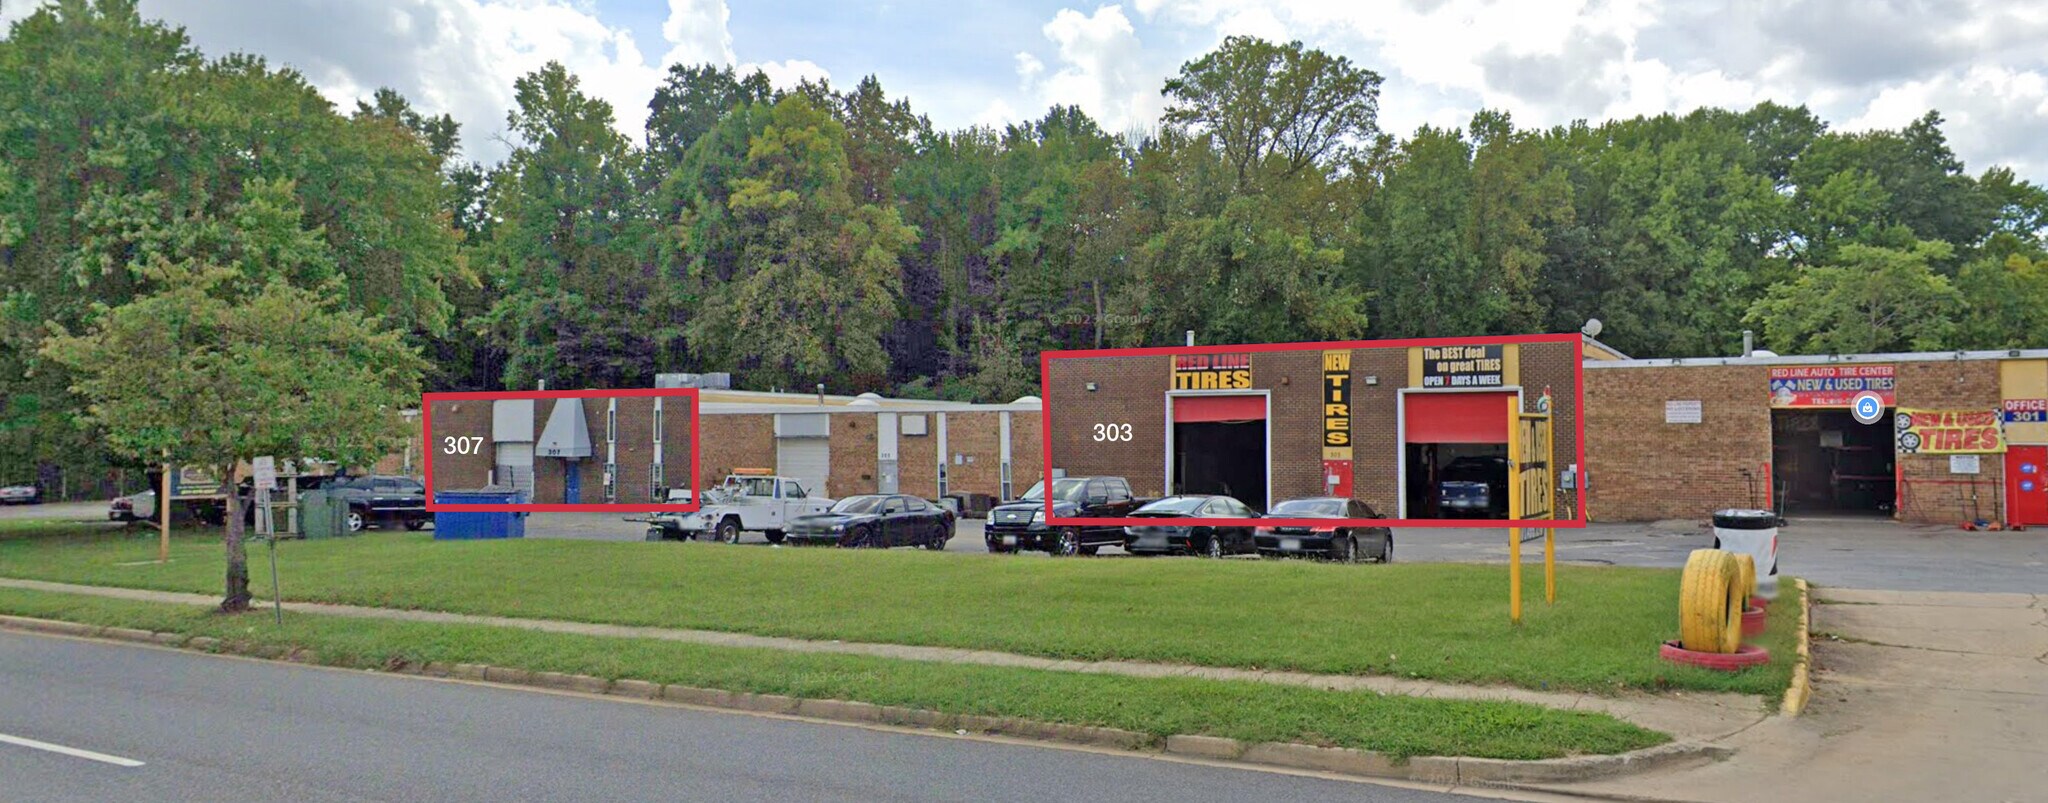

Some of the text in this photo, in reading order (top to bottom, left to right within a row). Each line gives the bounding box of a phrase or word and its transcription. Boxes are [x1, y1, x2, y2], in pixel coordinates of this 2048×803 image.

[1424, 346, 1485, 360] The BEST deal
[1176, 353, 1250, 370] RED LINE
[1324, 353, 1351, 371] NEW
[1436, 359, 1501, 373] on great TIRES
[1771, 366, 1894, 377] RED LINE AUTO TIRE CENTER
[1176, 370, 1250, 390] TIRES
[1424, 375, 1502, 386] OPEN 7 DAYS A WEEK
[1797, 377, 1894, 391] NEW & USED TIRES
[1326, 374, 1349, 445] TIRES
[2005, 400, 2046, 410] OFFICE
[1911, 411, 1941, 427] NEW
[2013, 411, 2040, 421] 301
[1919, 427, 1999, 450] TIRES
[1518, 467, 1549, 517] TIRES
